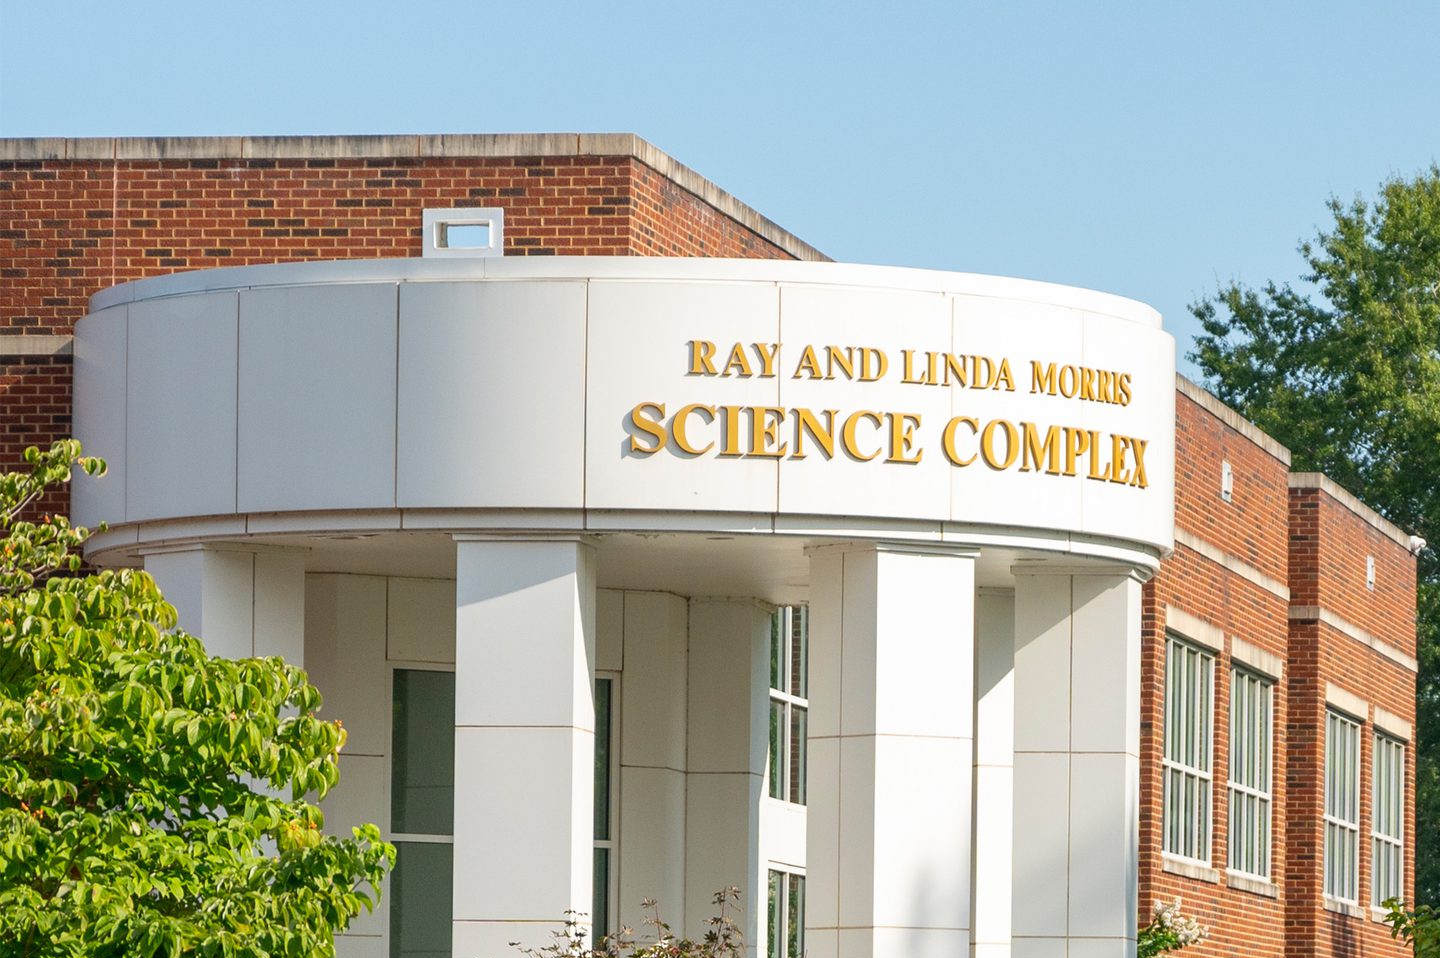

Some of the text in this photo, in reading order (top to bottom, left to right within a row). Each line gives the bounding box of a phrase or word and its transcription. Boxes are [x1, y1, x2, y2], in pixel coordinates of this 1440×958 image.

[686, 339, 1133, 407] RAY AND LINDA MORRIS
[628, 401, 1150, 490] SCIENCE COMPLEX
